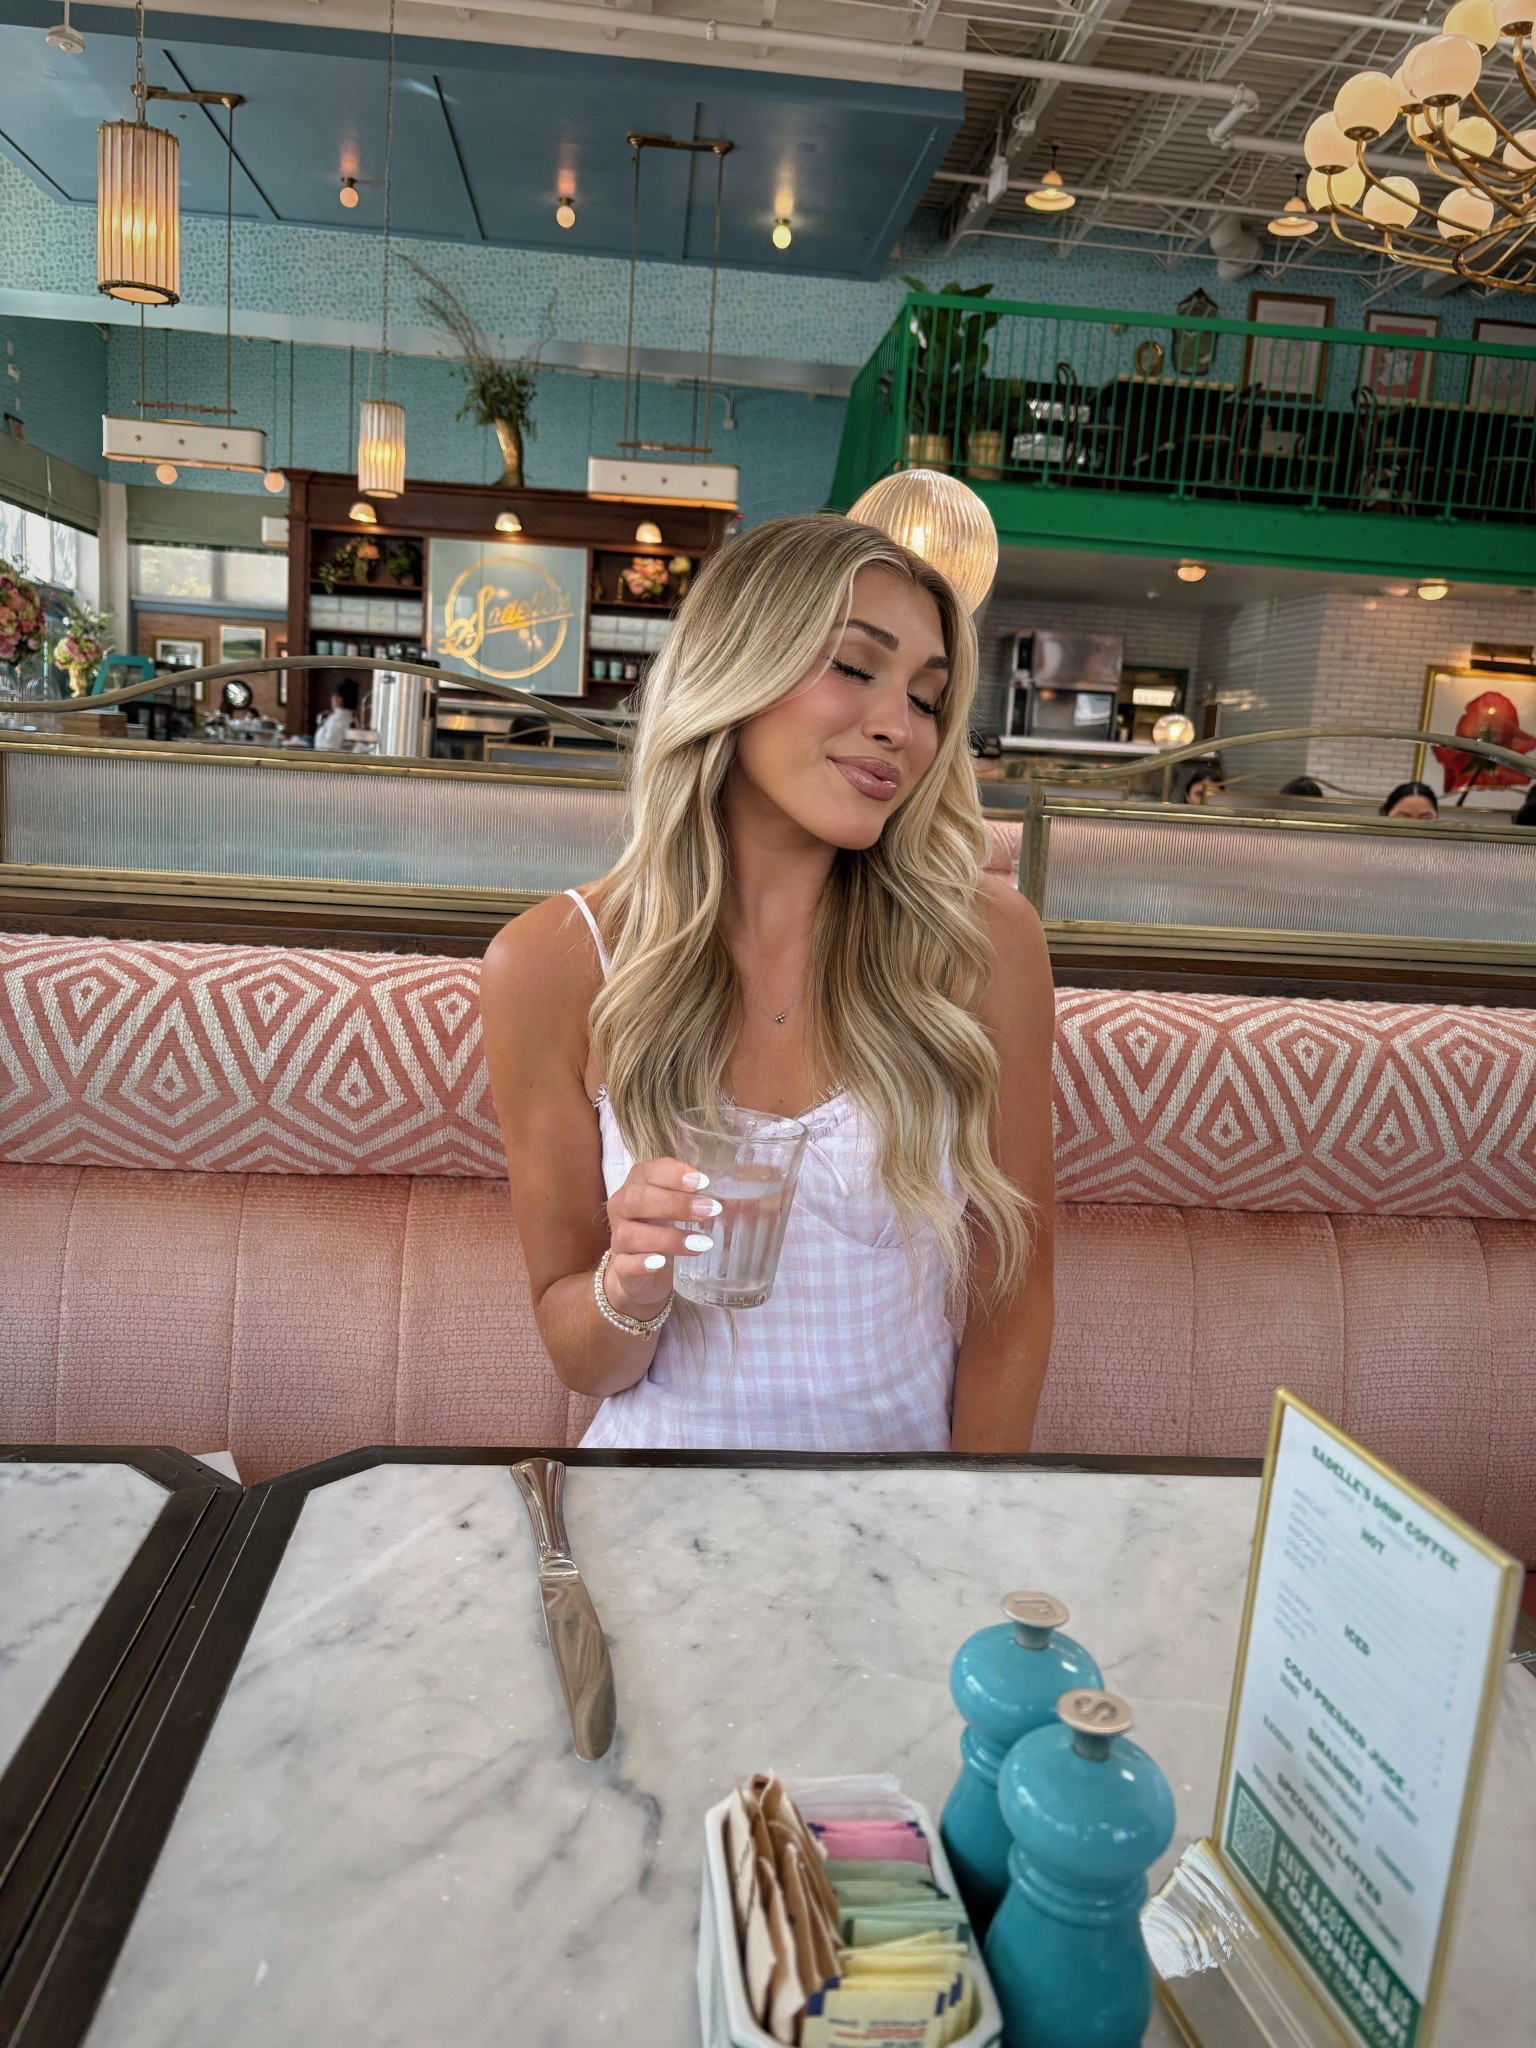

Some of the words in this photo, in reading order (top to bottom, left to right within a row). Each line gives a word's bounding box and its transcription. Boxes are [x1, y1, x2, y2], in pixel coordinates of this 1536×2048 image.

[1312, 1445, 1371, 1501] SADELLE'S
[1405, 1521, 1460, 1572] COFFEE
[1360, 1527, 1385, 1554] HOT
[1344, 1624, 1370, 1657] ICED
[1284, 1656, 1312, 1692] COLD
[1314, 1687, 1366, 1749] PRESSED
[1368, 1748, 1405, 1793] JUICE
[1277, 1773, 1336, 1848] SPECIALTY
[1336, 1844, 1382, 1906] LATTES
[1278, 1841, 1309, 1893] HAVE
[1309, 1884, 1319, 1908] A
[1320, 1897, 1367, 1969] COFFEE
[1367, 1957, 1390, 1998] ON
[1390, 1985, 1412, 2026] US
